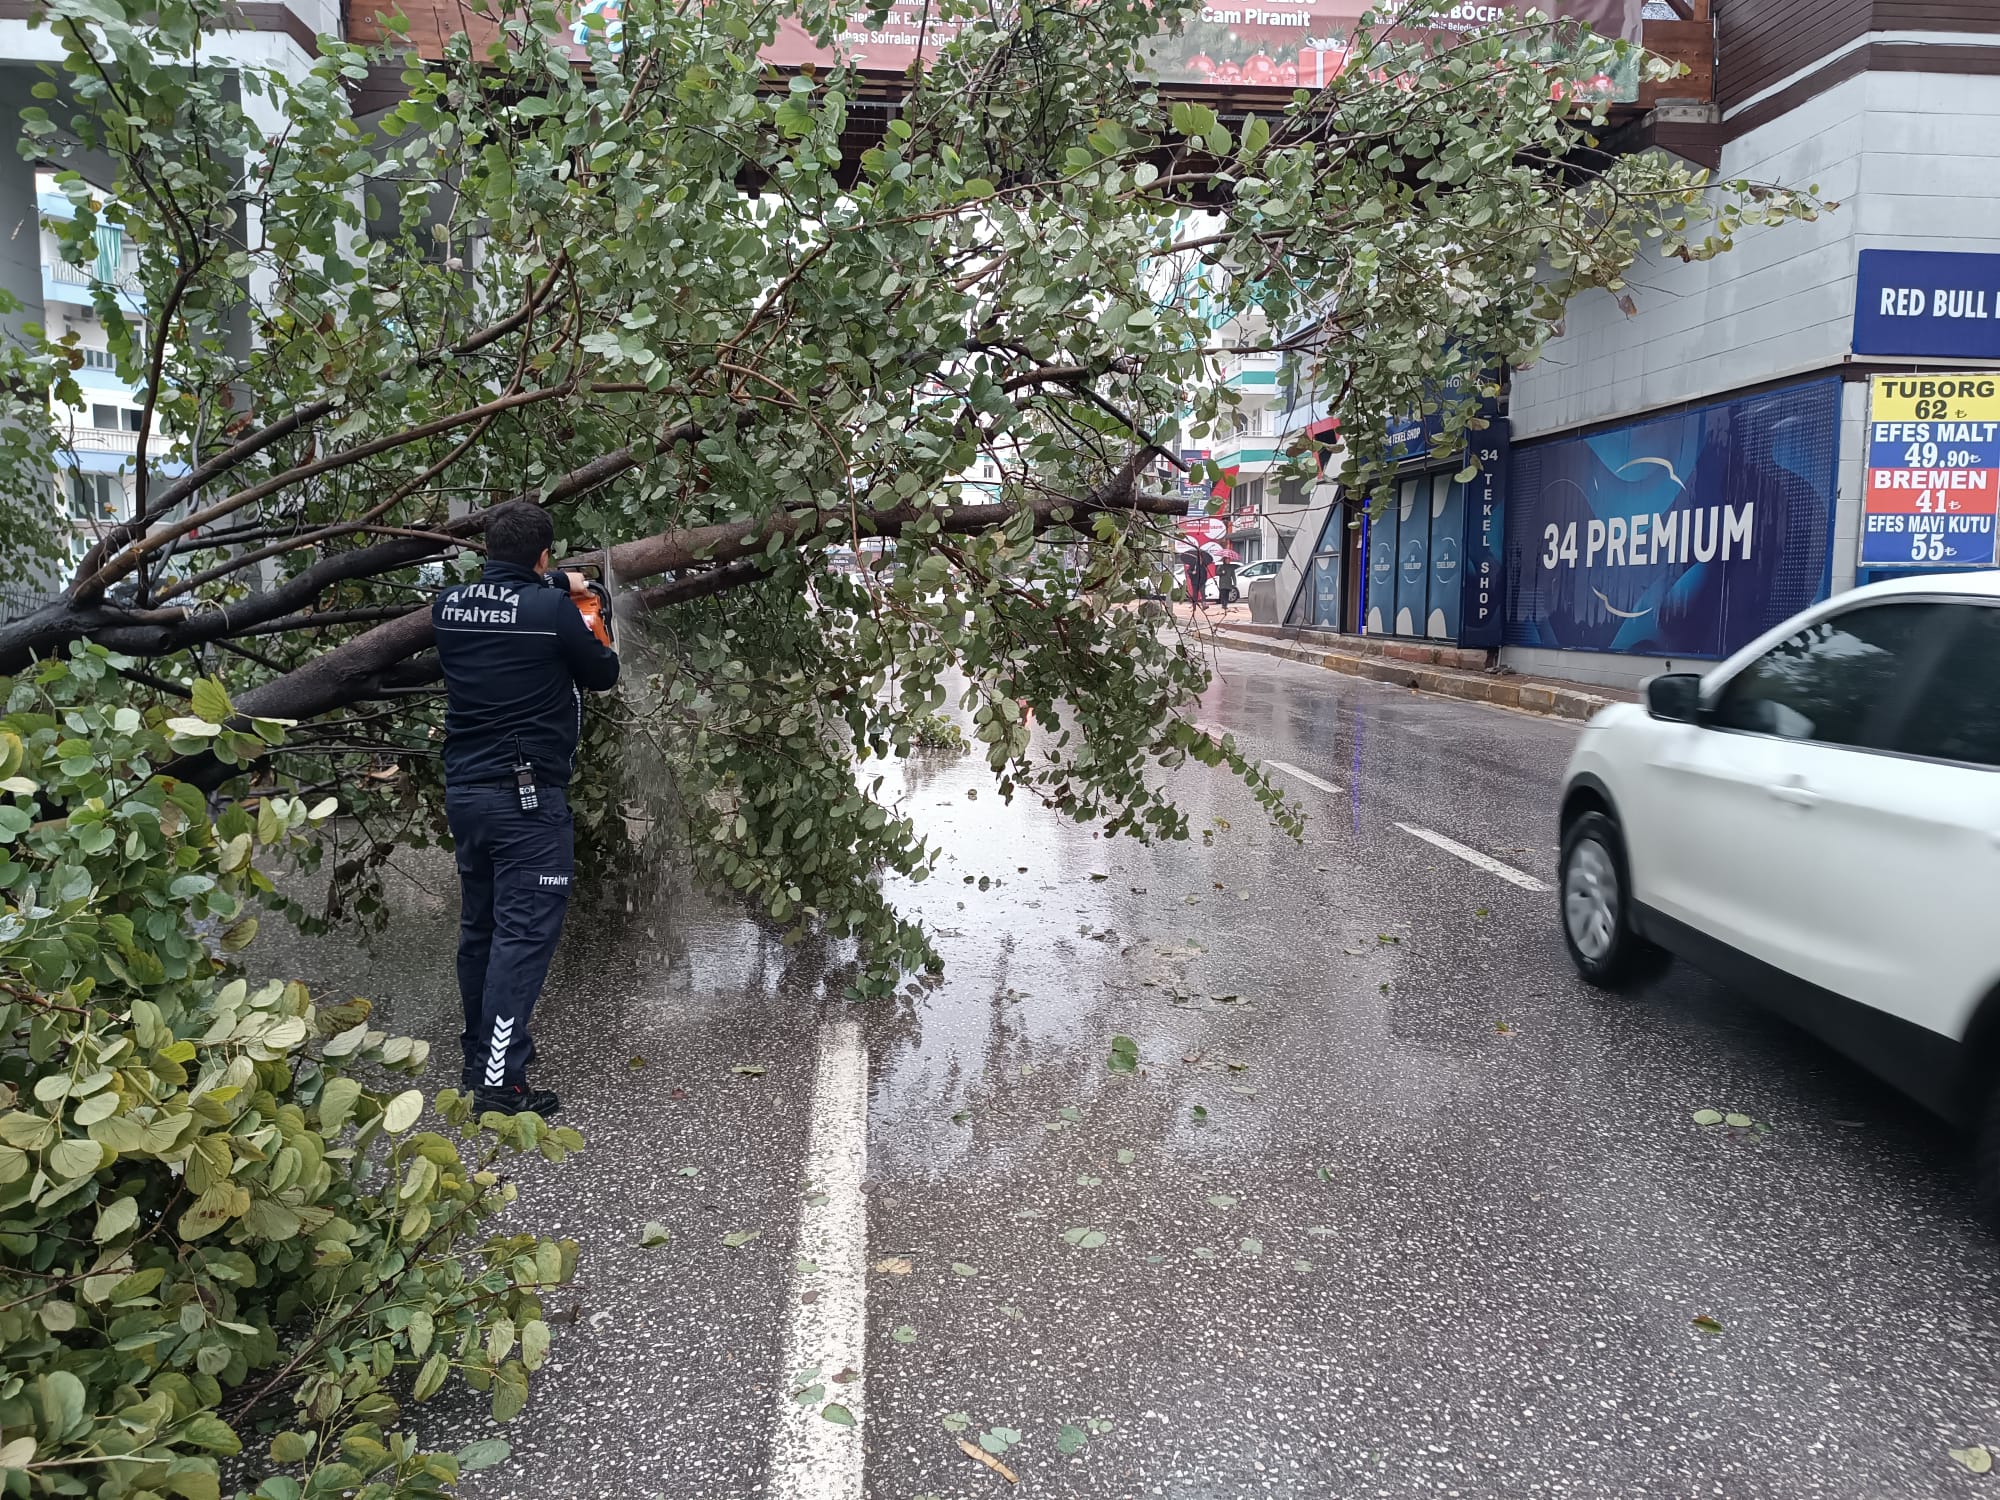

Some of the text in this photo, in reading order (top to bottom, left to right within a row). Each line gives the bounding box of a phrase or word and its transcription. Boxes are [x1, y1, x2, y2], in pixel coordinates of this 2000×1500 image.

[1200, 6, 1311, 26] Cam Piramit
[1879, 287, 1926, 317] RED
[1932, 289, 1988, 319] BULL
[1882, 380, 1995, 398] TUBORG
[1914, 399, 1948, 420] 62
[1407, 427, 1421, 441] SHOP
[1875, 423, 1998, 443] EFES MALT
[1480, 449, 1498, 461] 34
[1874, 470, 1987, 489] BREMEN
[1482, 473, 1492, 547] TEKEL
[1867, 515, 1905, 533] EFES
[1948, 516, 1991, 533] KUTU
[1542, 502, 1755, 570] 34 PREMIUM
[446, 583, 520, 607] ATALYA
[1479, 562, 1489, 619] SHOP
[441, 604, 517, 624] İTFAİYESİ
[539, 875, 569, 884] İTFAİYE
